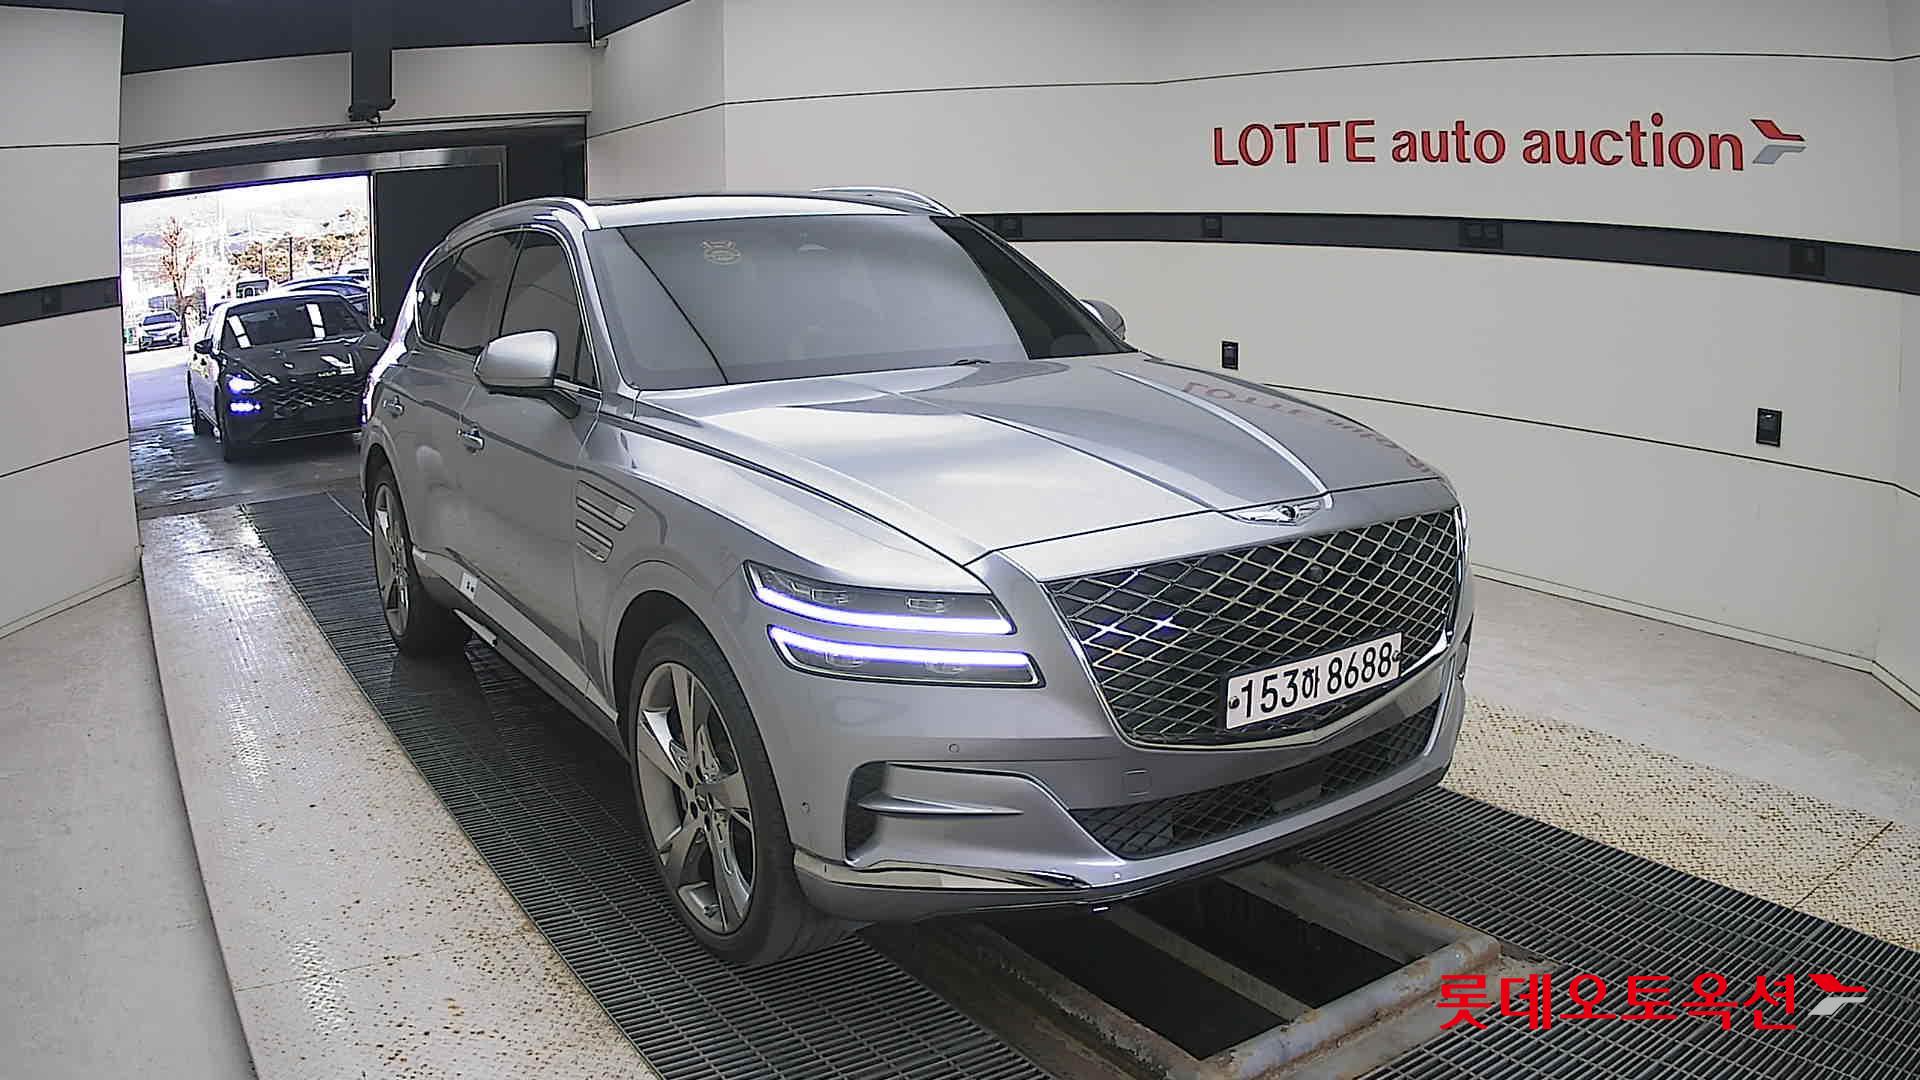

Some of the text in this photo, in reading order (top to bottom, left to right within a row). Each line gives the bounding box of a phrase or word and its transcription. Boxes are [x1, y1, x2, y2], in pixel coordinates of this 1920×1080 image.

[1213, 113, 1745, 171] LOTTE auto auction
[1241, 642, 1392, 718] 153하 8688
